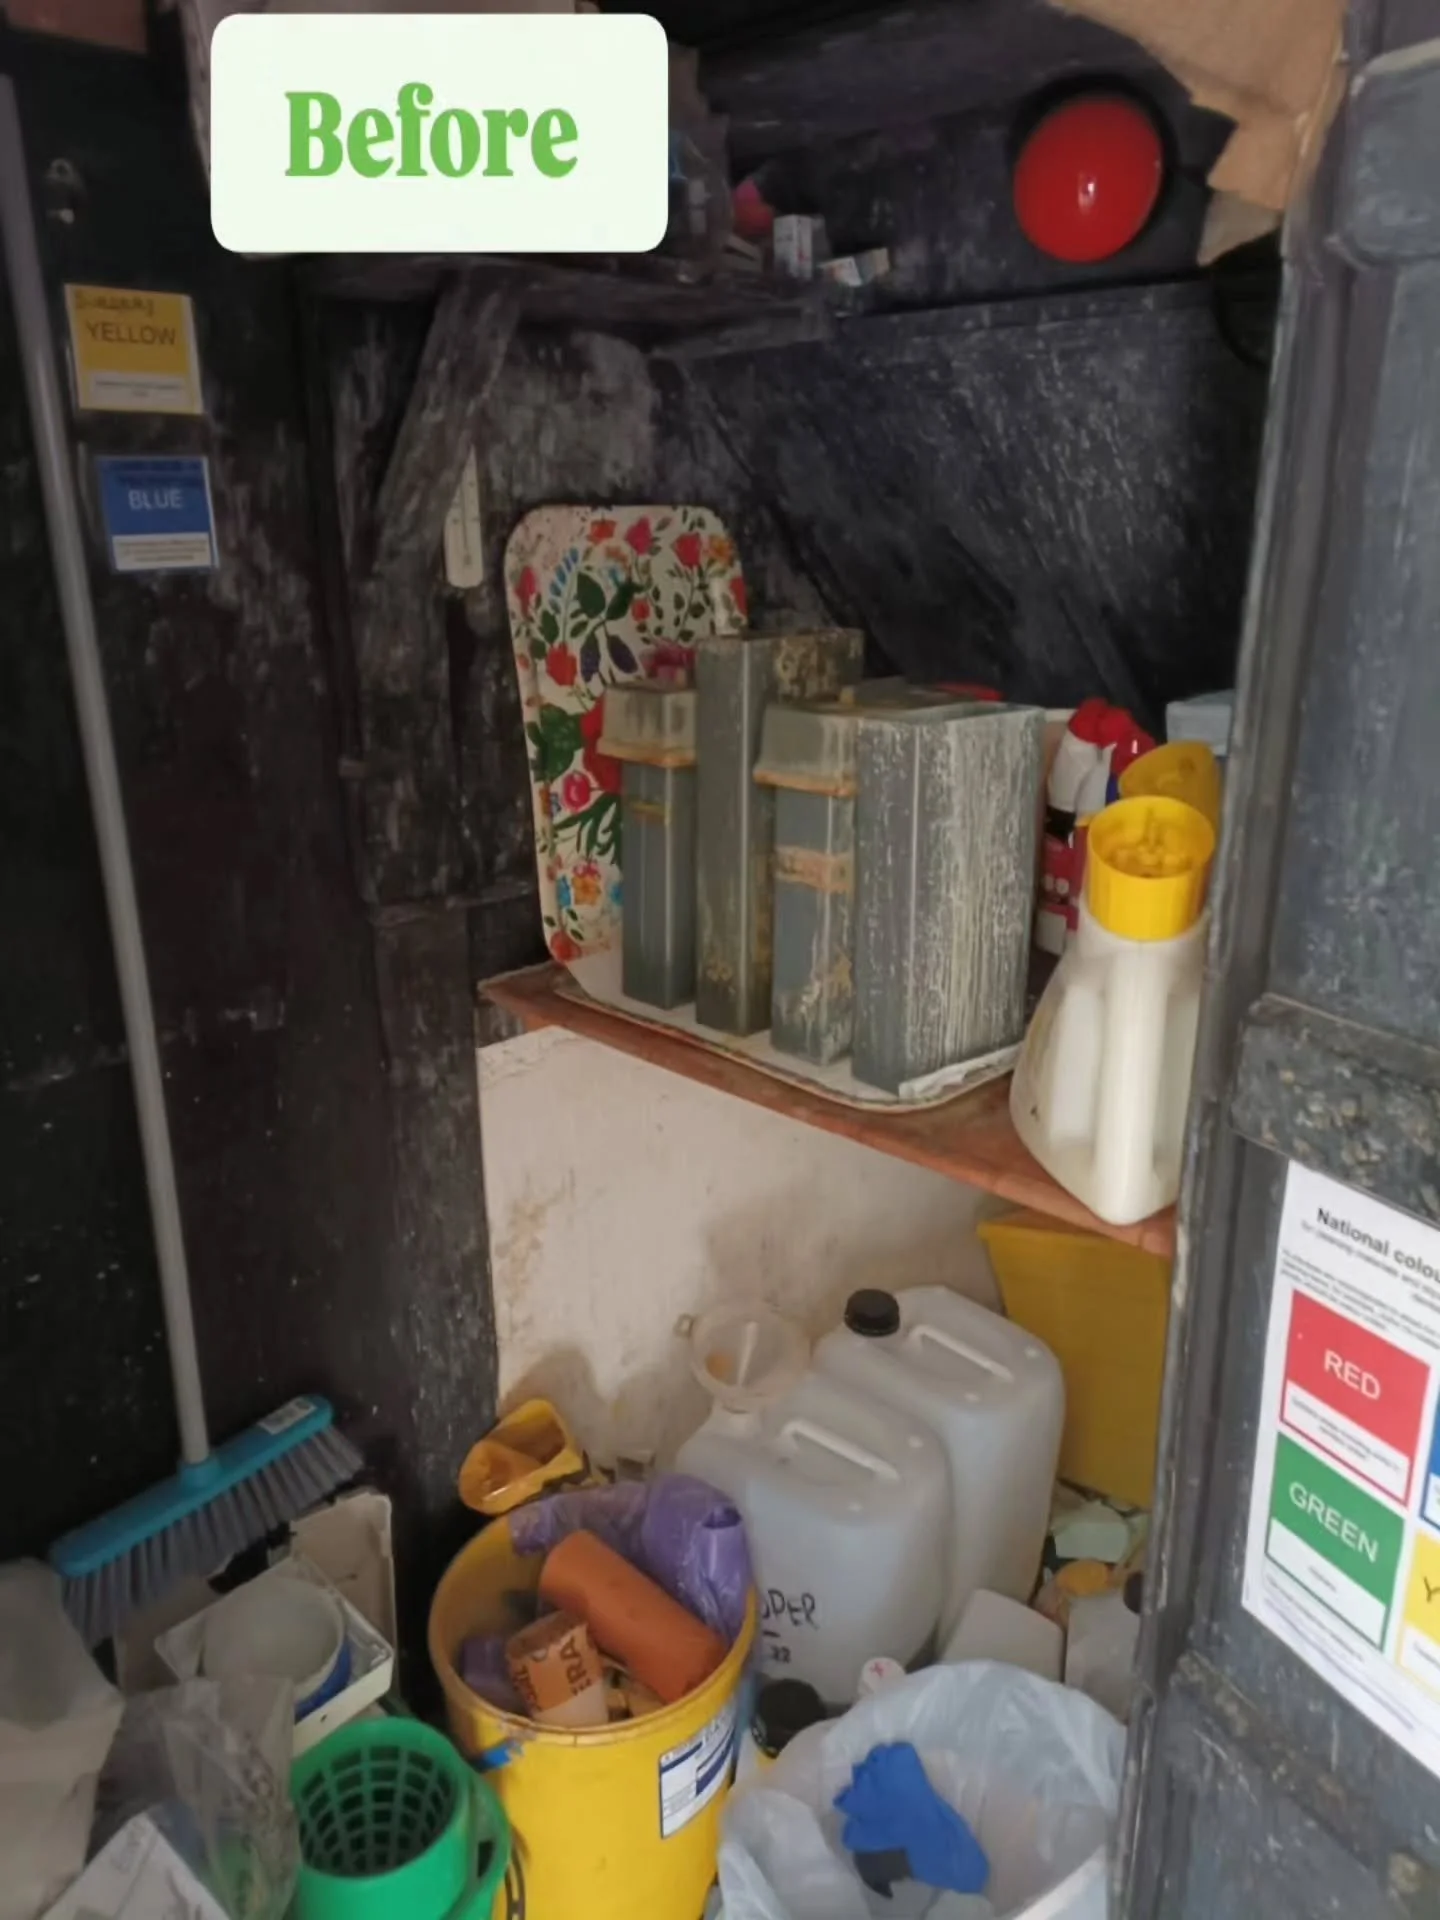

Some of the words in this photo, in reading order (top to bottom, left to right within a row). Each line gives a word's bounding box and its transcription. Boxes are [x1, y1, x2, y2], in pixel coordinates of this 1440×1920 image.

[86, 320, 177, 346] YELLOW
[127, 487, 183, 511] BLUE
[1316, 1207, 1390, 1258] National
[1323, 1348, 1382, 1400] RED
[1288, 1480, 1380, 1564] GREEN
